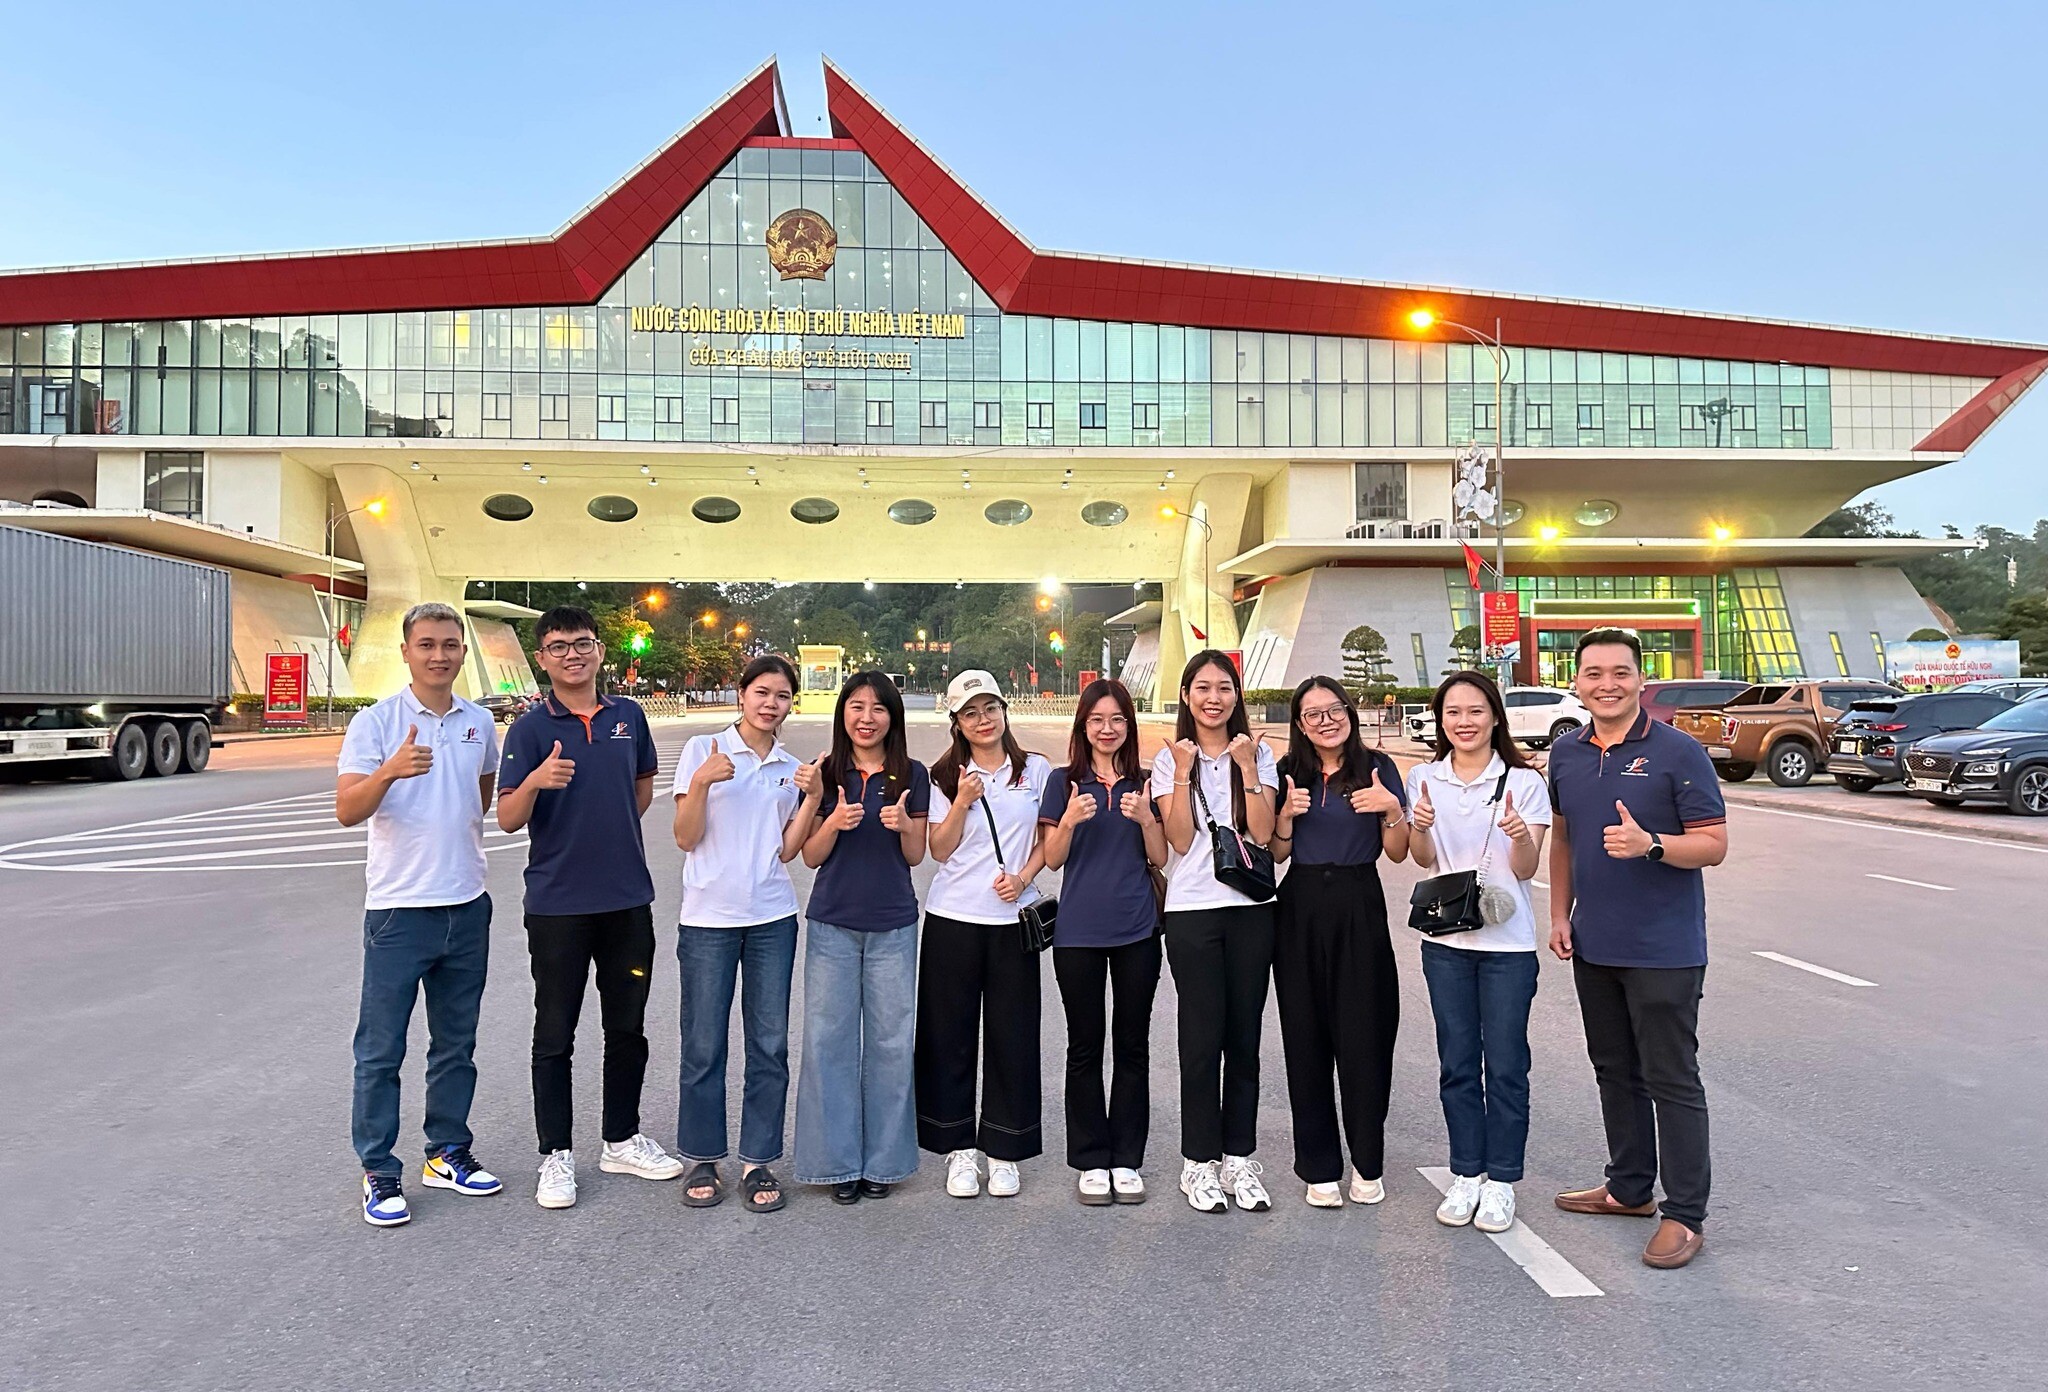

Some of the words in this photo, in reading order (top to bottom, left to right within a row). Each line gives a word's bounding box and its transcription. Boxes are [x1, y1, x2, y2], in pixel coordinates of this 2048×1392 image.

[631, 301, 675, 332] NƯỚC
[679, 302, 722, 339] CỘNG
[725, 303, 757, 334] HÒA
[759, 303, 782, 335] XÃ
[785, 304, 810, 342] HỘI
[814, 304, 845, 336] CHỦ
[849, 306, 896, 337] NGHĨA
[898, 307, 929, 345] VIỆT
[931, 313, 965, 339] NAM
[689, 341, 720, 366] CỬA
[723, 340, 769, 367] KHẨU
[771, 343, 812, 369] QUỐC
[815, 343, 836, 368] TẾ
[837, 347, 870, 369] HỮU
[873, 351, 912, 375] NGHỊ
